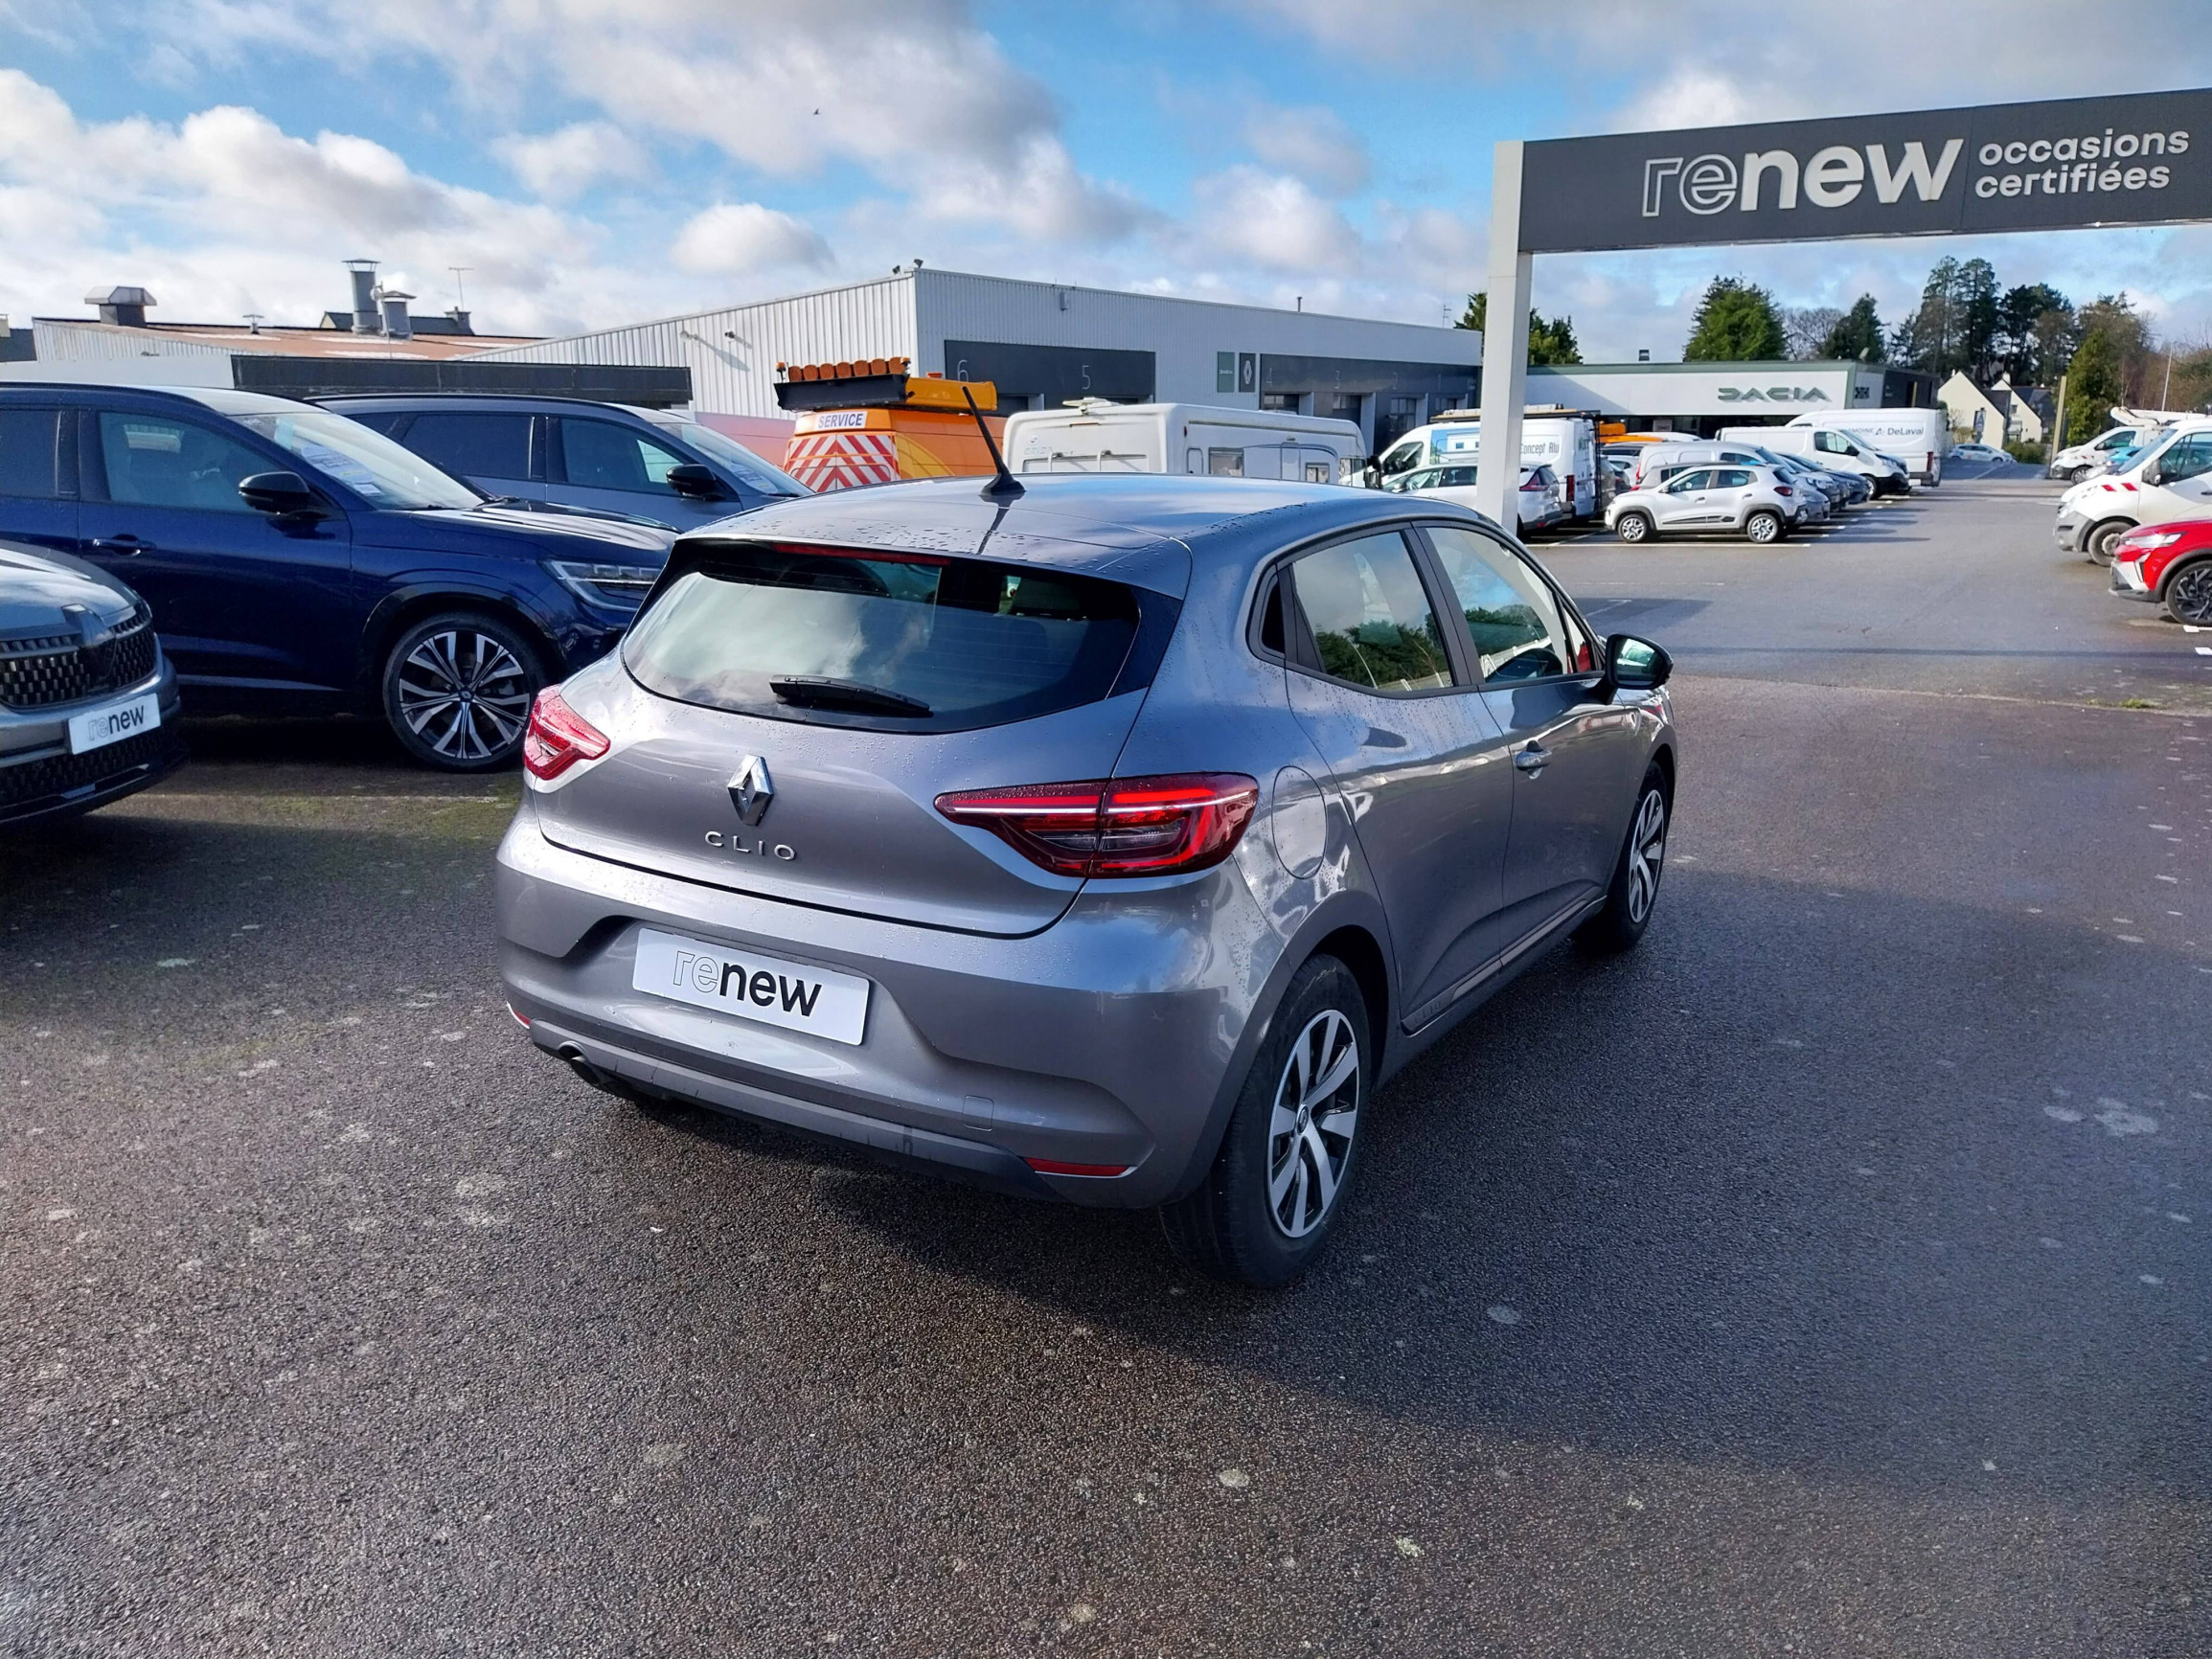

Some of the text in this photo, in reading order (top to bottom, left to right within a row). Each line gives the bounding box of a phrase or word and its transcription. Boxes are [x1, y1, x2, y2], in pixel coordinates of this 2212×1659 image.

[1978, 128, 2190, 166] occasions
[1642, 139, 1964, 216] renew
[1975, 161, 2170, 198] certifiées
[1082, 365, 1091, 390] 5
[1718, 387, 1827, 400] DACIA
[818, 413, 863, 428] SERVICE
[1887, 427, 1924, 436] DeLaval
[88, 705, 144, 741] renew
[705, 831, 796, 860] CLIO
[673, 951, 822, 1017] renew
